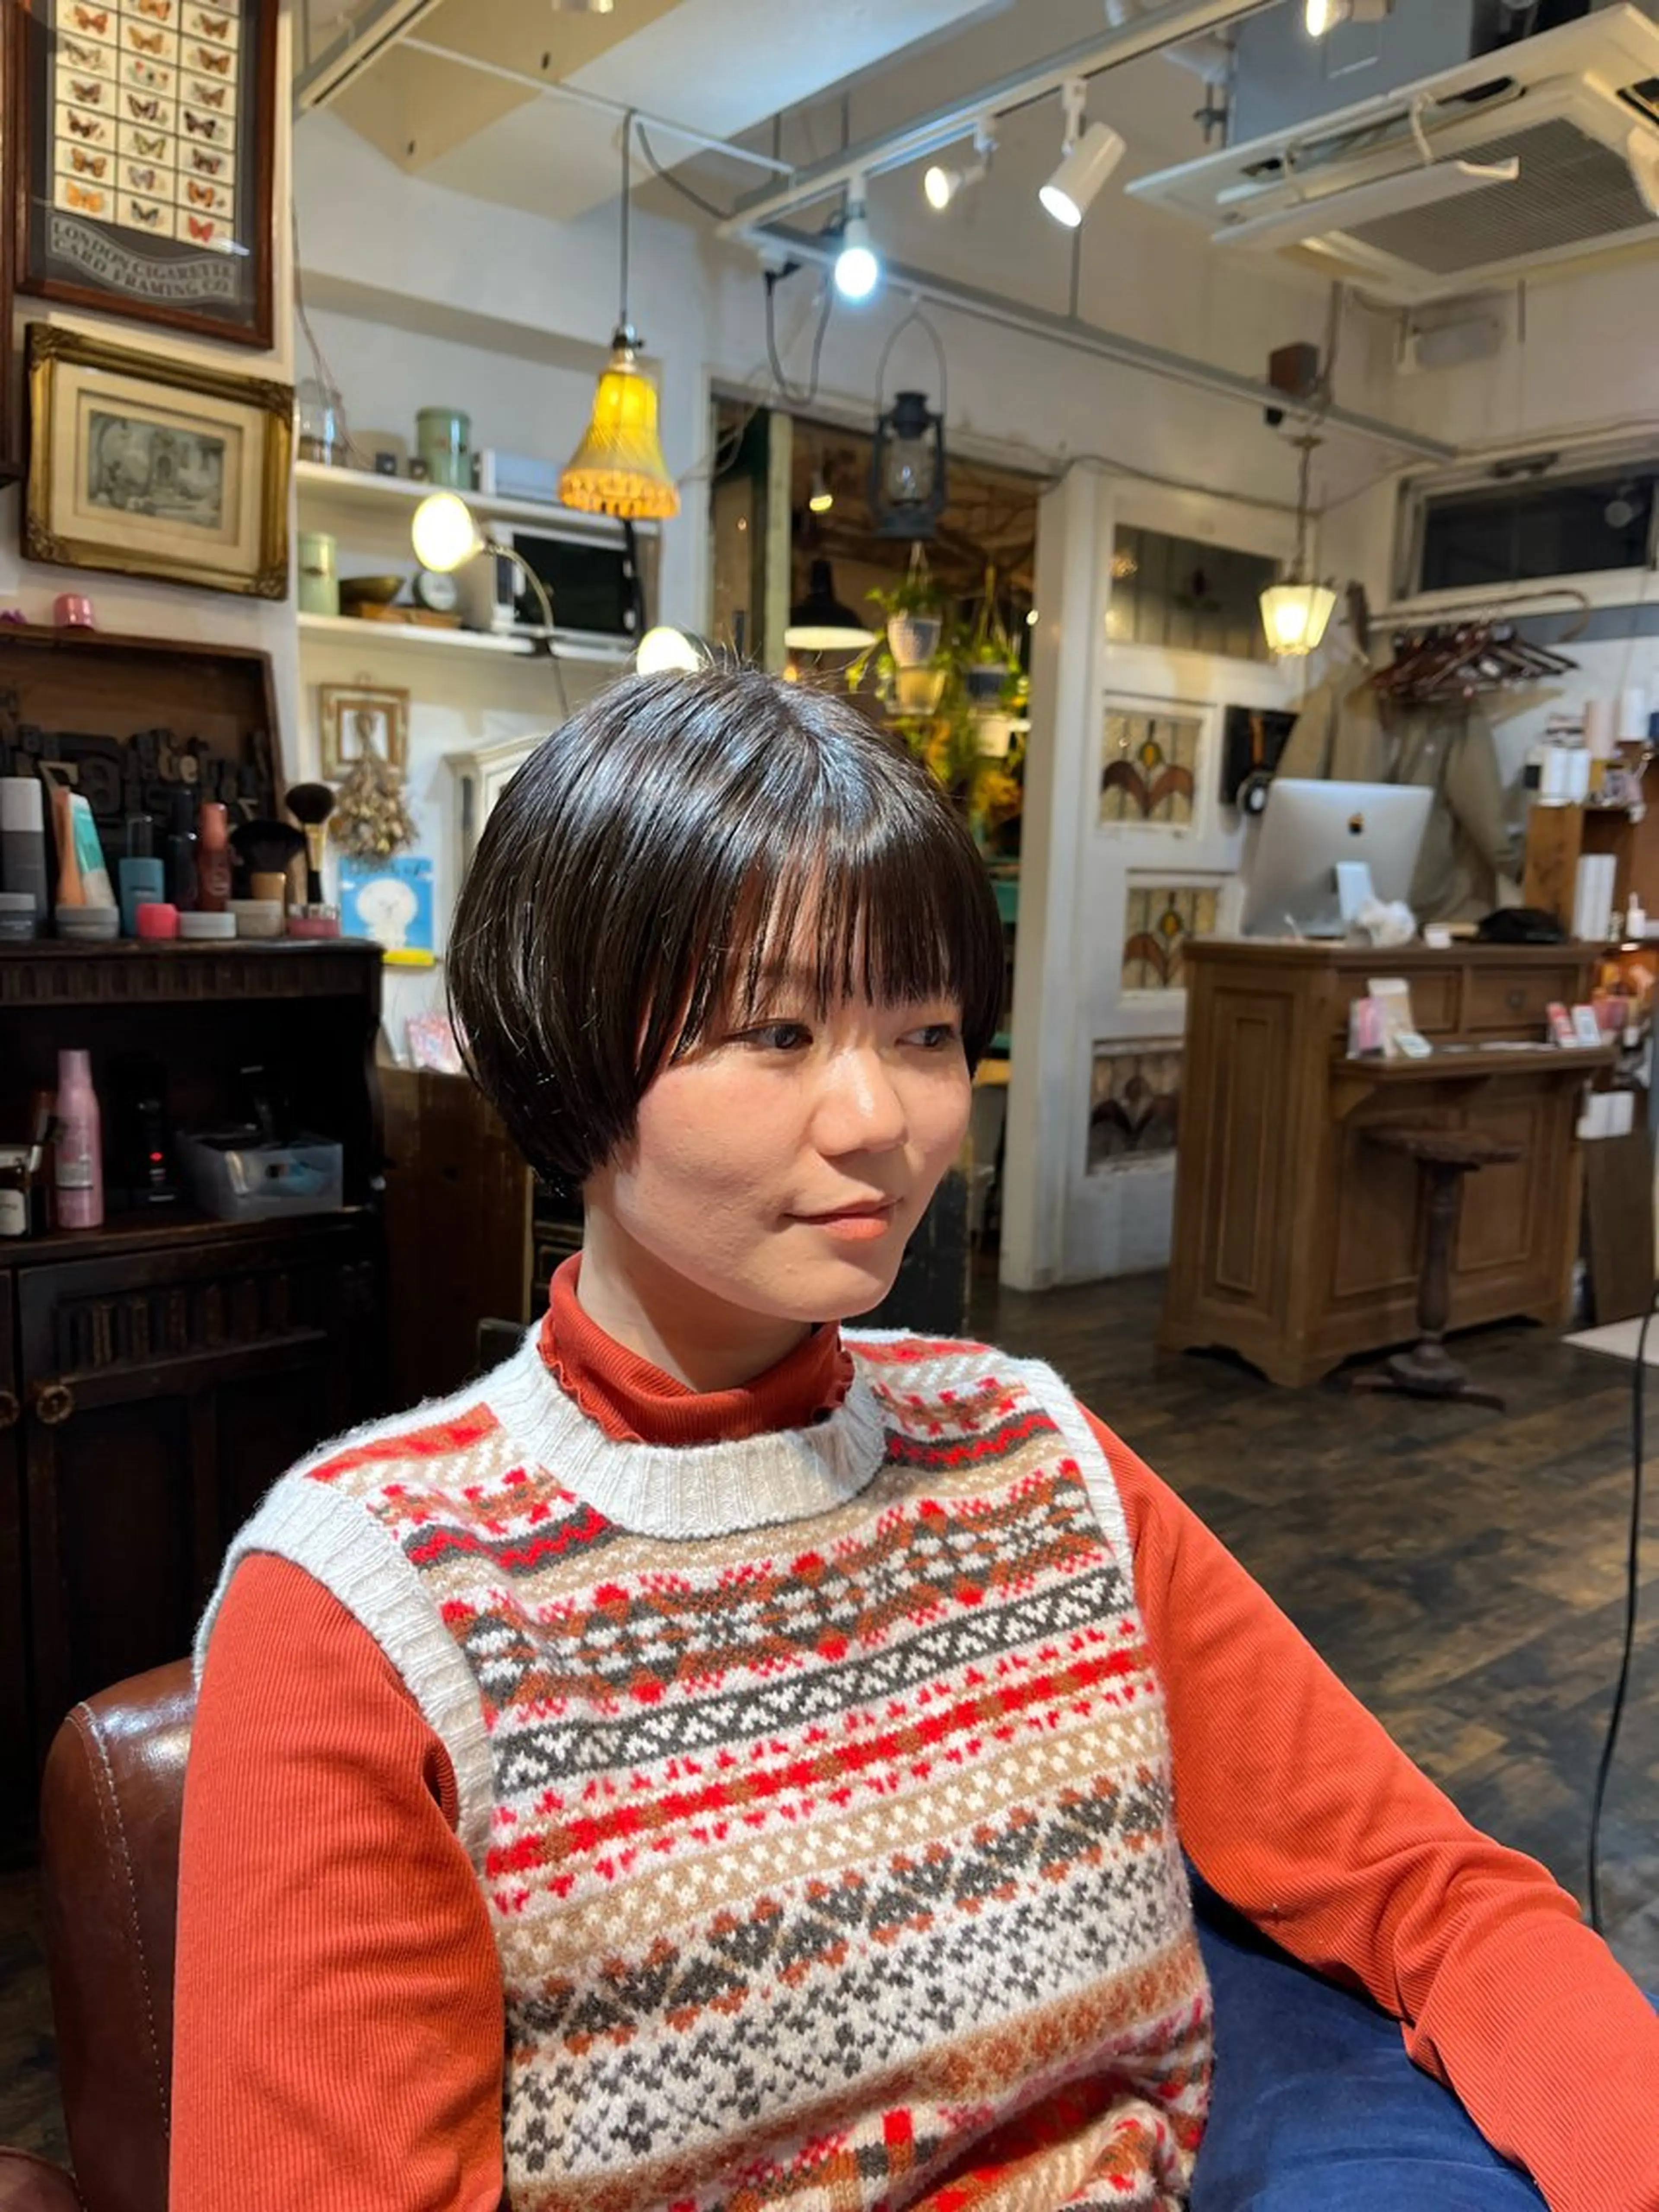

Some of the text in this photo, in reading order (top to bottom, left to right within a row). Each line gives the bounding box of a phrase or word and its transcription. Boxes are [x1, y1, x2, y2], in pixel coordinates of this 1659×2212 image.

[53, 222, 229, 279] LONDON CIGARETTE
[113, 268, 199, 296] FRAMING
